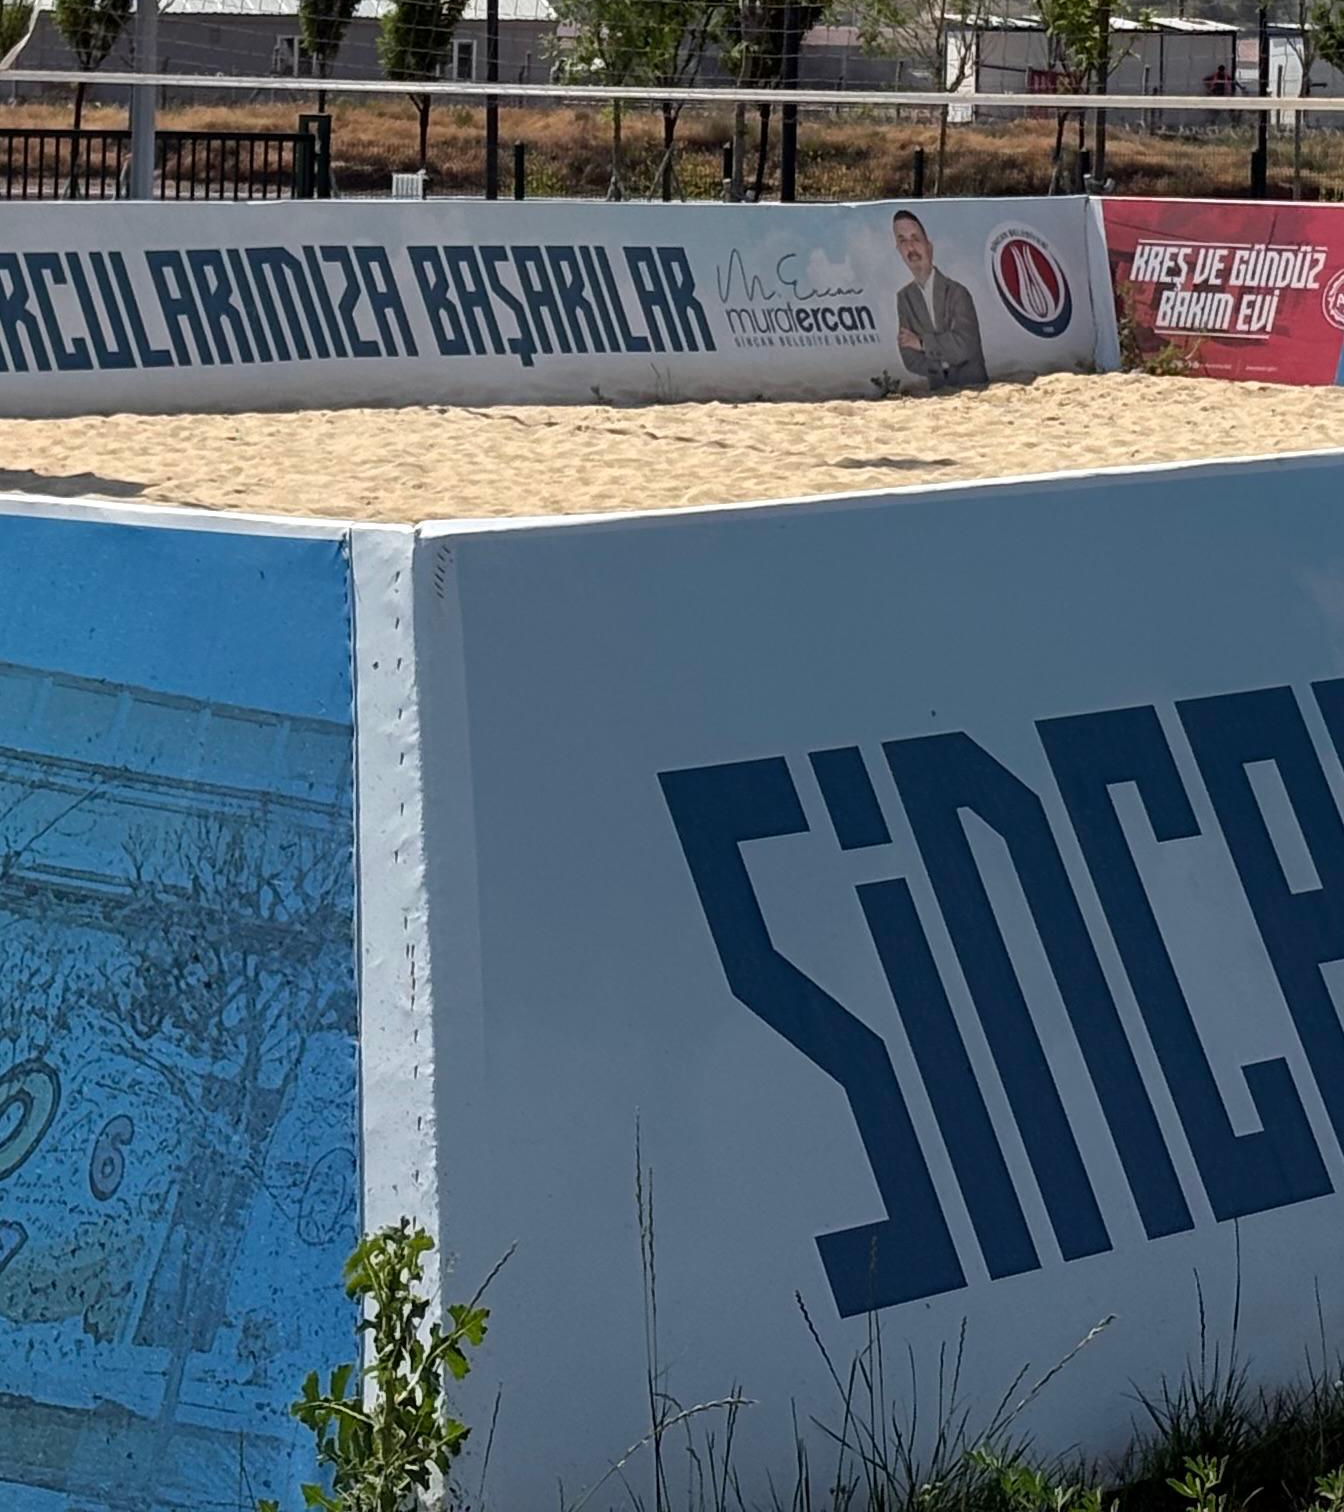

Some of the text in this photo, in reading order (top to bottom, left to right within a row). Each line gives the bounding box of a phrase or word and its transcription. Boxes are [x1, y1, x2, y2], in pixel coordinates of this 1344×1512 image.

[1130, 243, 1327, 292] KREŞ VE GÜNDÜZ
[406, 244, 717, 368] BAŞARILAR
[1156, 289, 1280, 333] BAKIM EVİ
